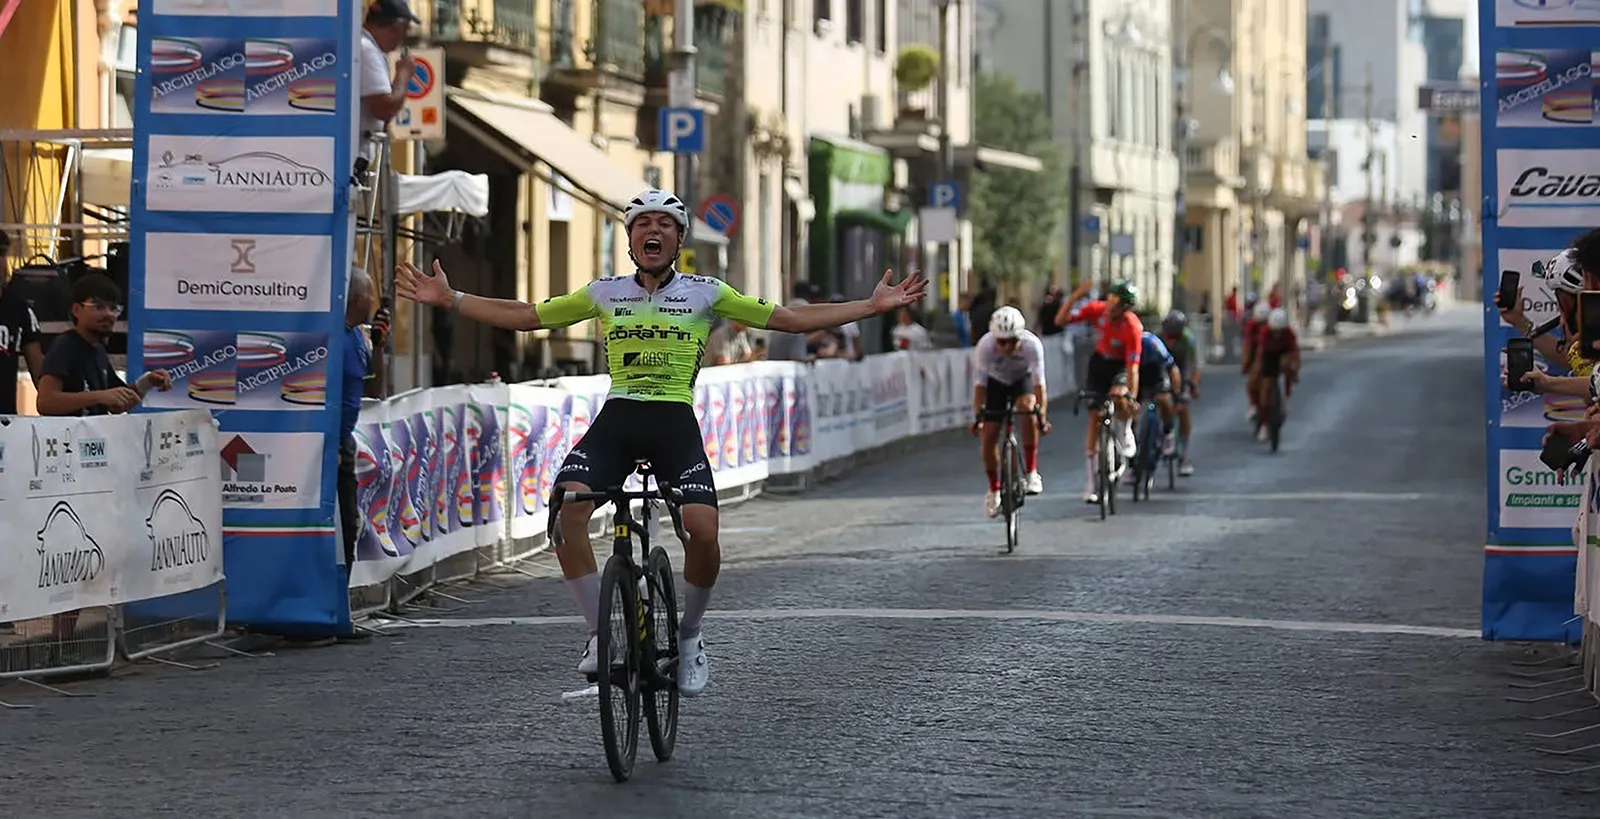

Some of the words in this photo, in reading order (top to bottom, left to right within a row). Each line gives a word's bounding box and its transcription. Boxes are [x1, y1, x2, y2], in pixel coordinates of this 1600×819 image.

[152, 52, 245, 98] ARCIPELAGO
[246, 53, 336, 101] ARCIPELAGO
[1498, 62, 1591, 112] ARCIPELAGO
[667, 112, 696, 149] P
[178, 280, 308, 300] DemiConsulting
[168, 345, 237, 383] CIPELAGO
[238, 346, 328, 394] ARCIPELAGO
